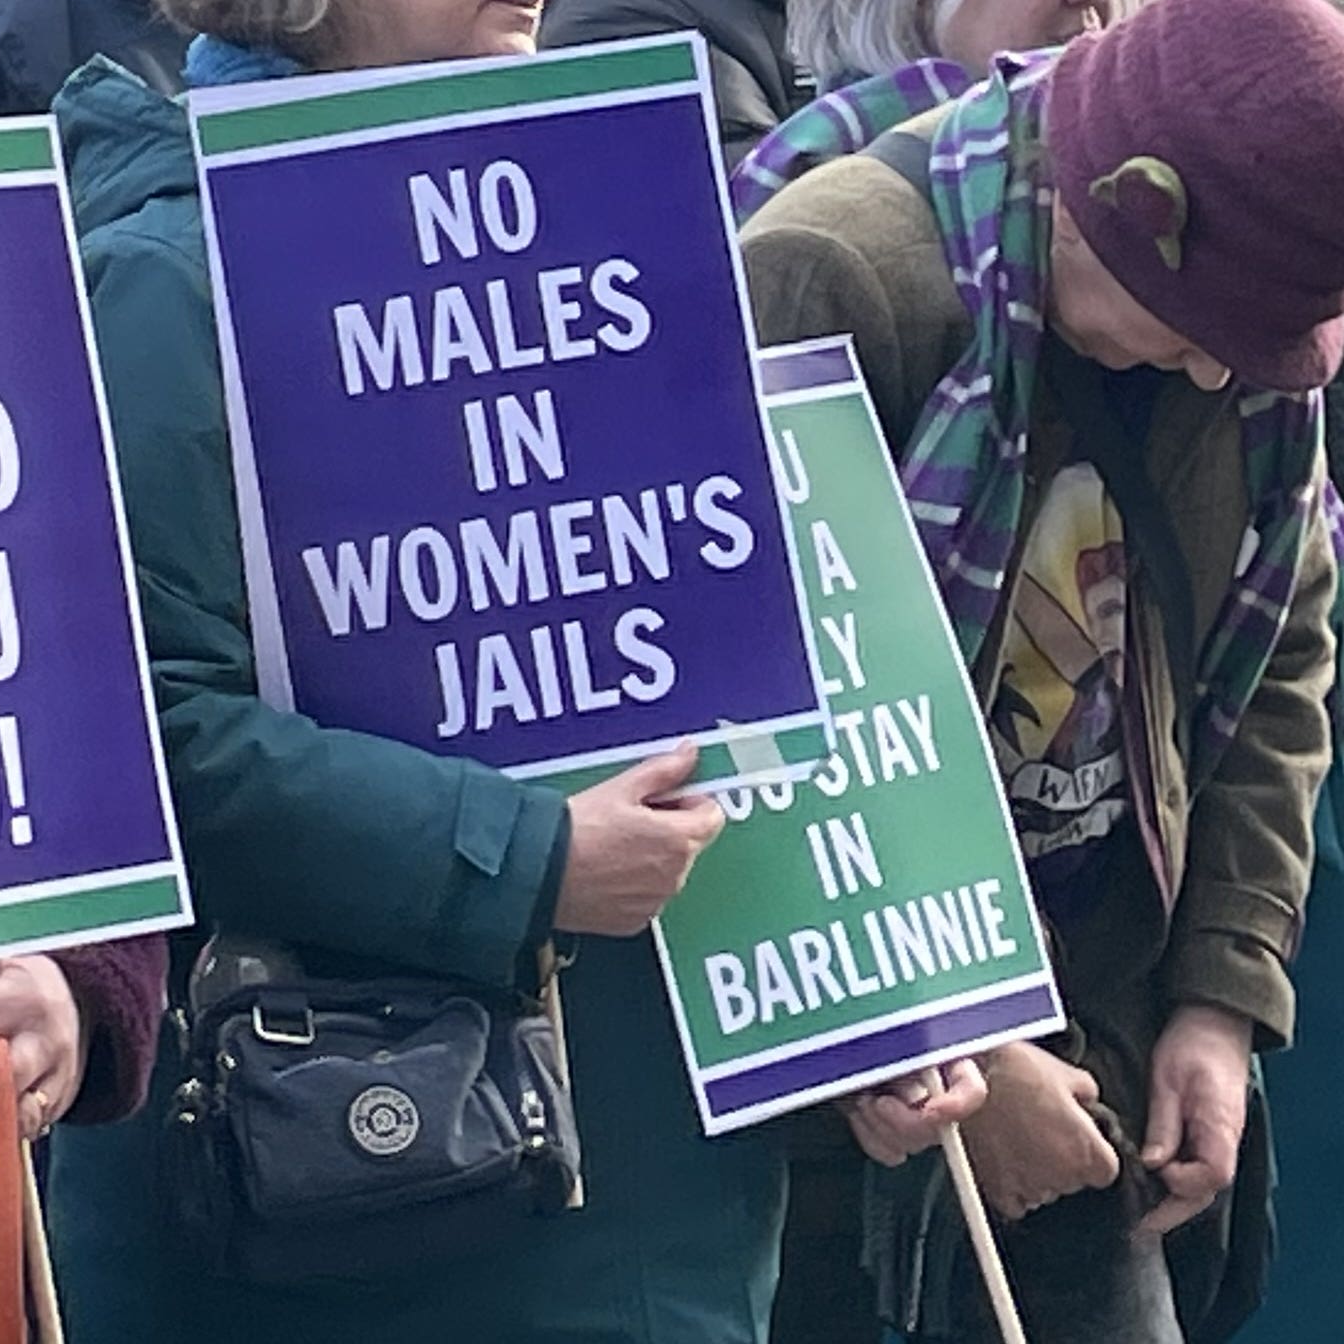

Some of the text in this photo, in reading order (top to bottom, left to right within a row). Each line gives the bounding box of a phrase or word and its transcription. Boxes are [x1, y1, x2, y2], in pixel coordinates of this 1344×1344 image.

[409, 160, 537, 264] NO
[334, 258, 652, 395] MALES
[463, 388, 565, 492] IN
[301, 476, 754, 637] WOMEN'S
[811, 520, 857, 596] A
[435, 607, 677, 739] JAILS
[806, 812, 882, 901] IN
[704, 878, 1016, 1036] BARLINNIE
